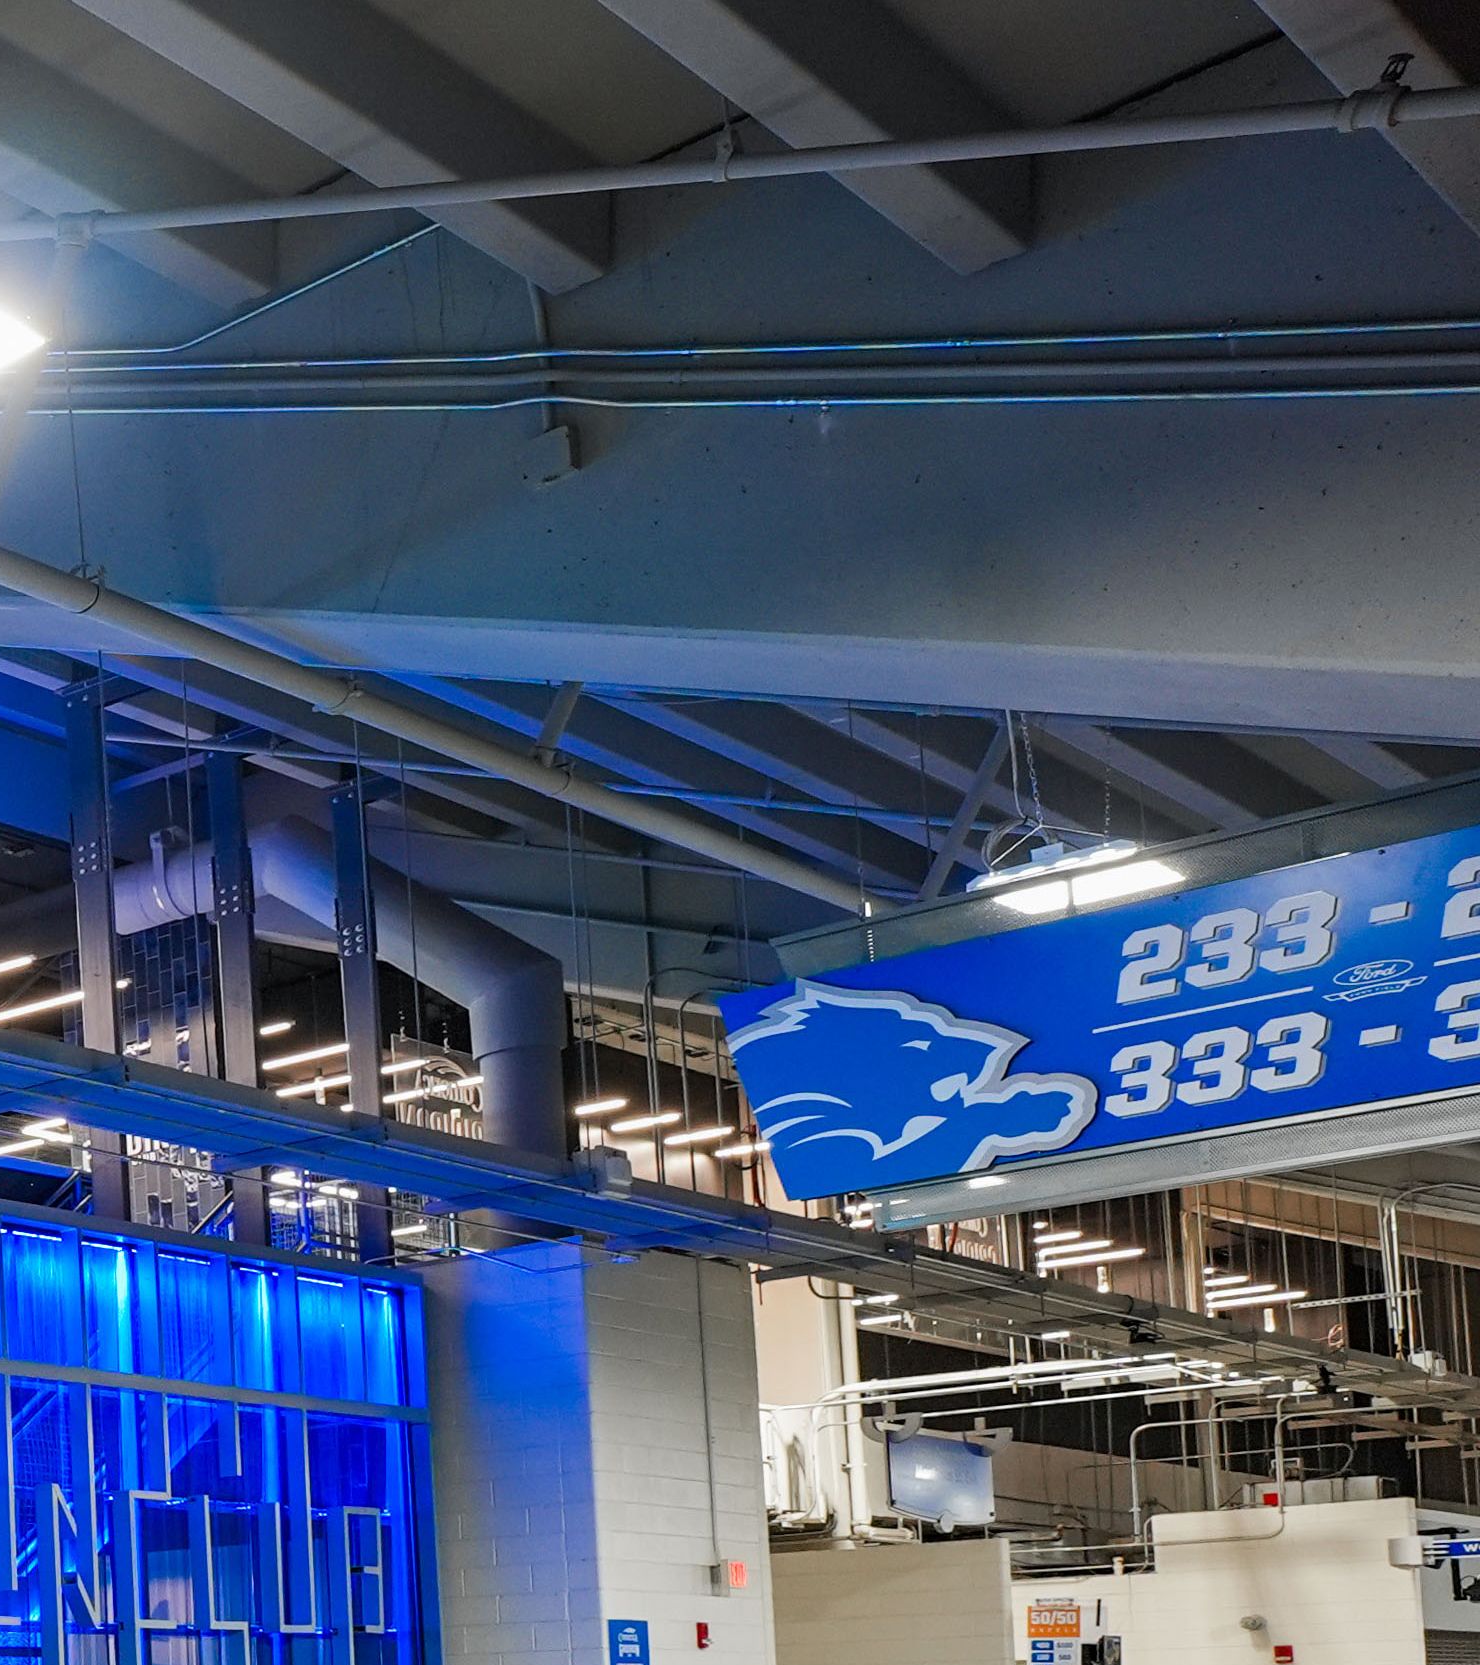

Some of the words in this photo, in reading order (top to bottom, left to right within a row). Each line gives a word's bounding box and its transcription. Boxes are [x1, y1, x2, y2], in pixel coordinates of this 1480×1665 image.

[1117, 890, 1338, 1005] 233
[1349, 963, 1397, 983] Ford
[1104, 1012, 1330, 1119] 333
[1031, 1611, 1078, 1625] 50/50
